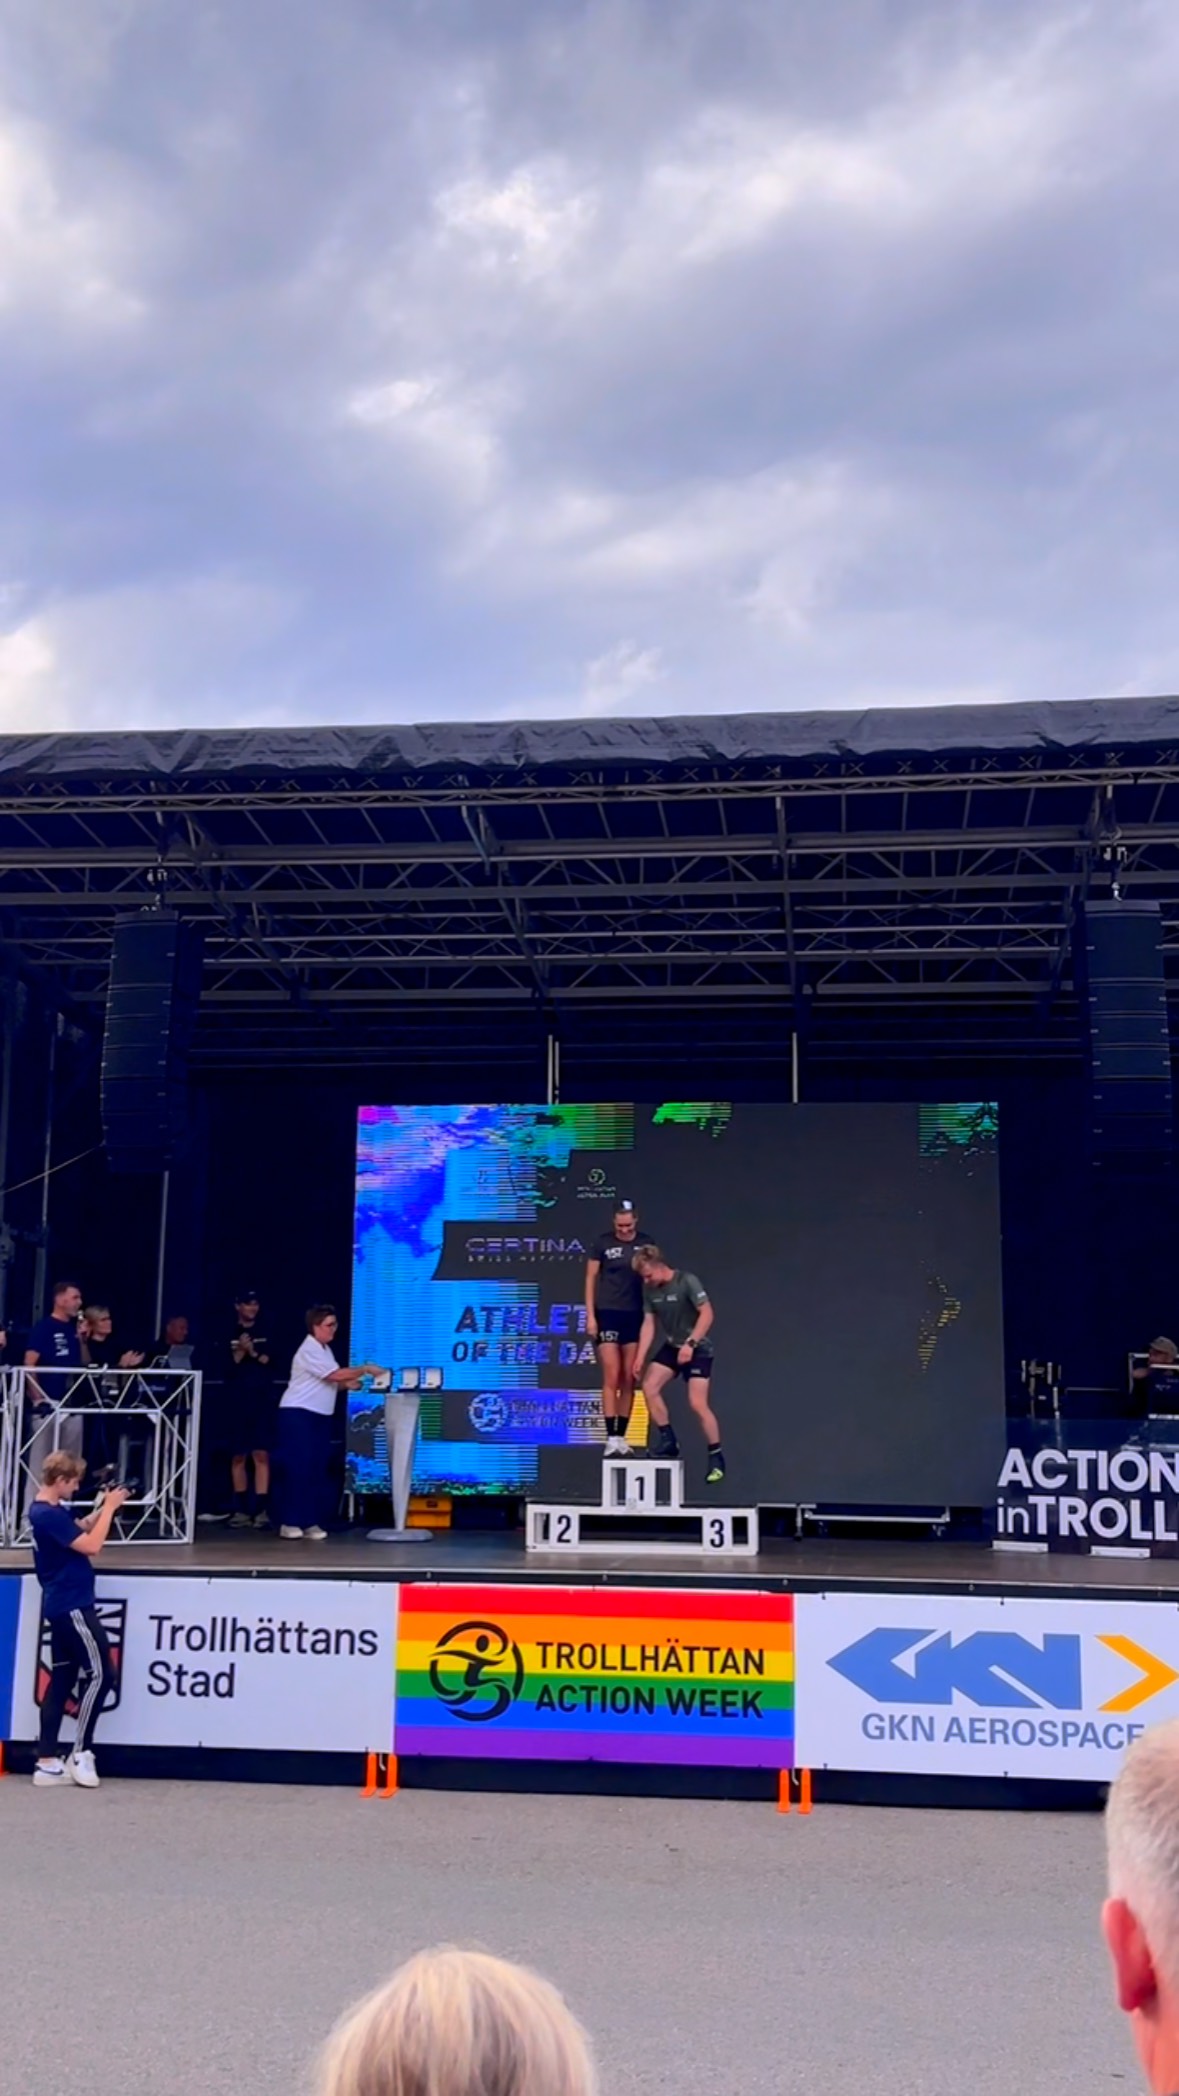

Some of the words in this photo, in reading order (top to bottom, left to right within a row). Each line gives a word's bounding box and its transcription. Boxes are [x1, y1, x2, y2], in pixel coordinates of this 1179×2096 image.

[465, 1238, 586, 1253] CERTINA
[605, 1247, 623, 1259] 157
[455, 1305, 588, 1334] ATHLET
[600, 1331, 619, 1341] 157
[452, 1341, 488, 1363] OF
[558, 1341, 597, 1364] DA
[997, 1448, 1179, 1493] ACTION
[634, 1476, 645, 1501] 1
[557, 1514, 571, 1543] 2
[997, 1495, 1178, 1541] inTROLL
[709, 1519, 725, 1548] 3
[149, 1615, 378, 1656] Trollhättans
[535, 1638, 764, 1675] TROLLHÄTTAN
[147, 1660, 235, 1699] Stad
[535, 1684, 655, 1715] ACTION
[666, 1687, 764, 1719] WEEK
[861, 1713, 935, 1742] GKN
